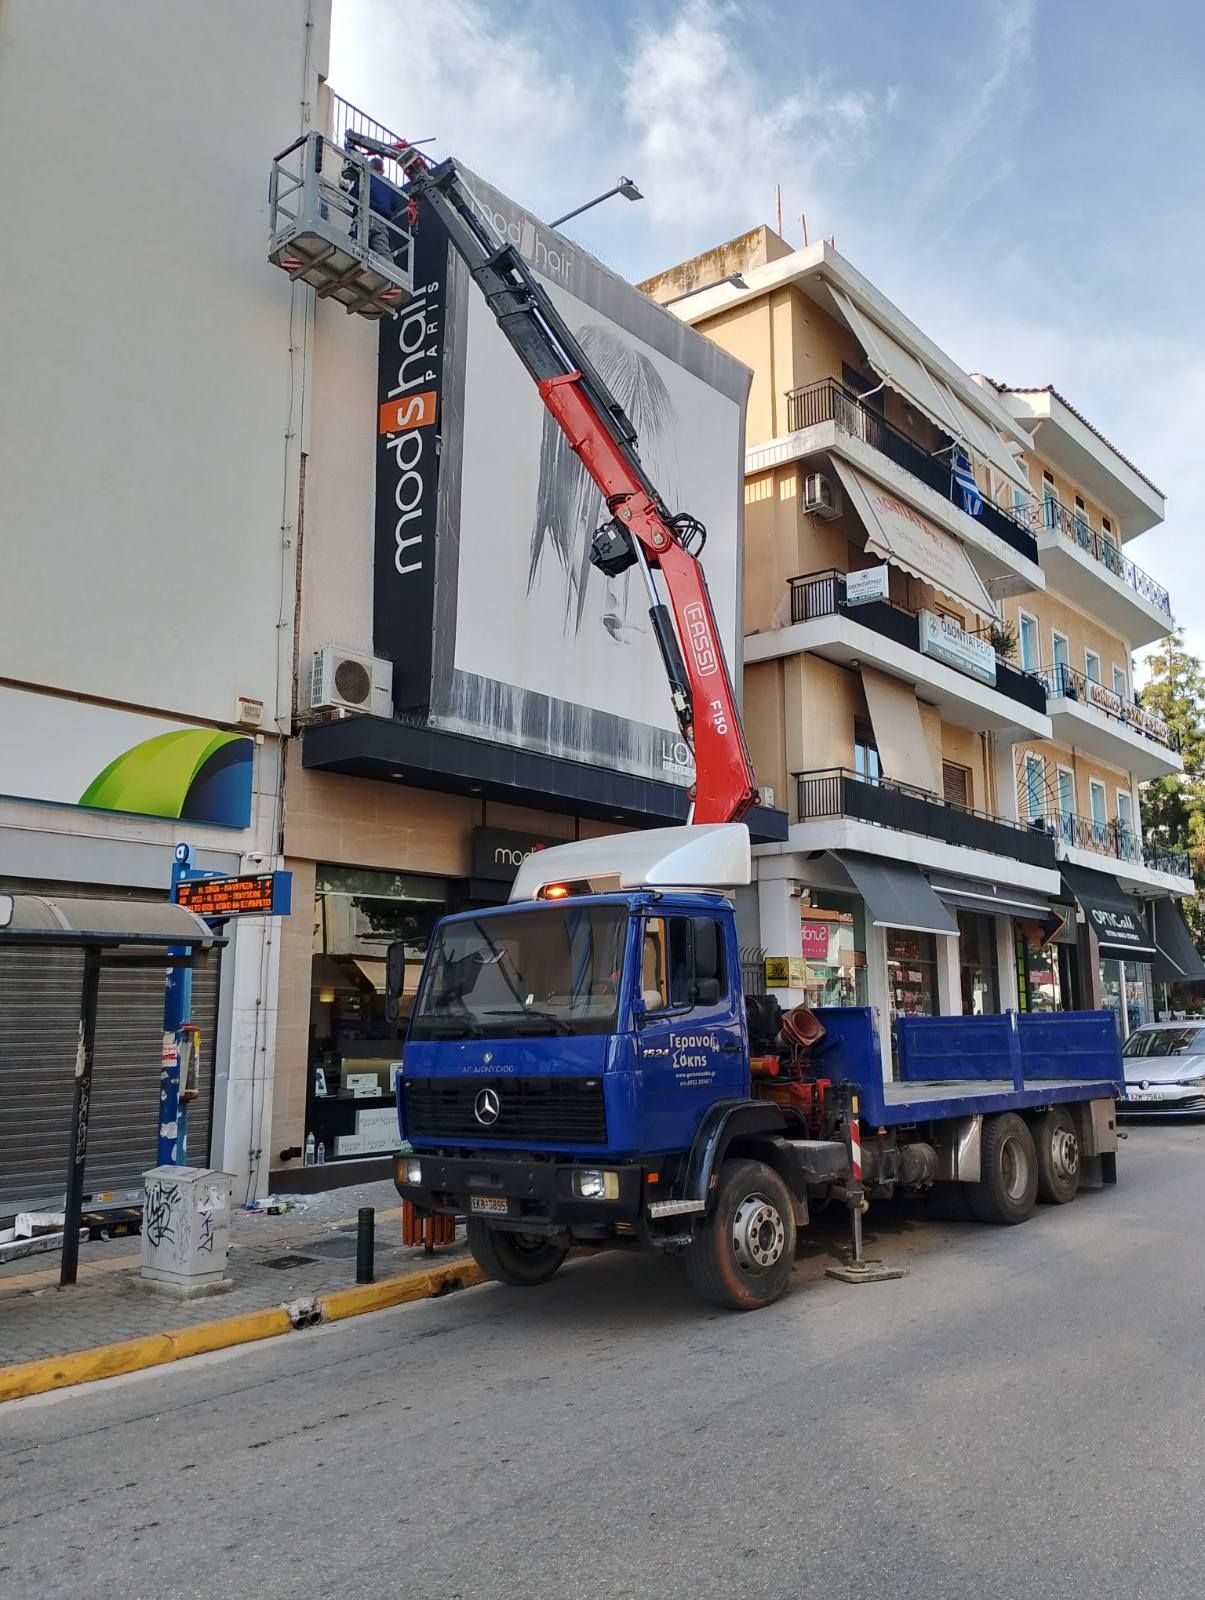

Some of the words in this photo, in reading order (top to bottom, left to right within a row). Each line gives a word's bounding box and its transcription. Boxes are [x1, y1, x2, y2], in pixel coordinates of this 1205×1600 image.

[425, 281, 439, 381] PARIS
[687, 606, 716, 673] FASSI
[940, 620, 992, 657] ΟΔΟΝΤΙΑΤΡΕΙΟ
[710, 700, 728, 735] F150
[643, 1048, 669, 1058] 1524
